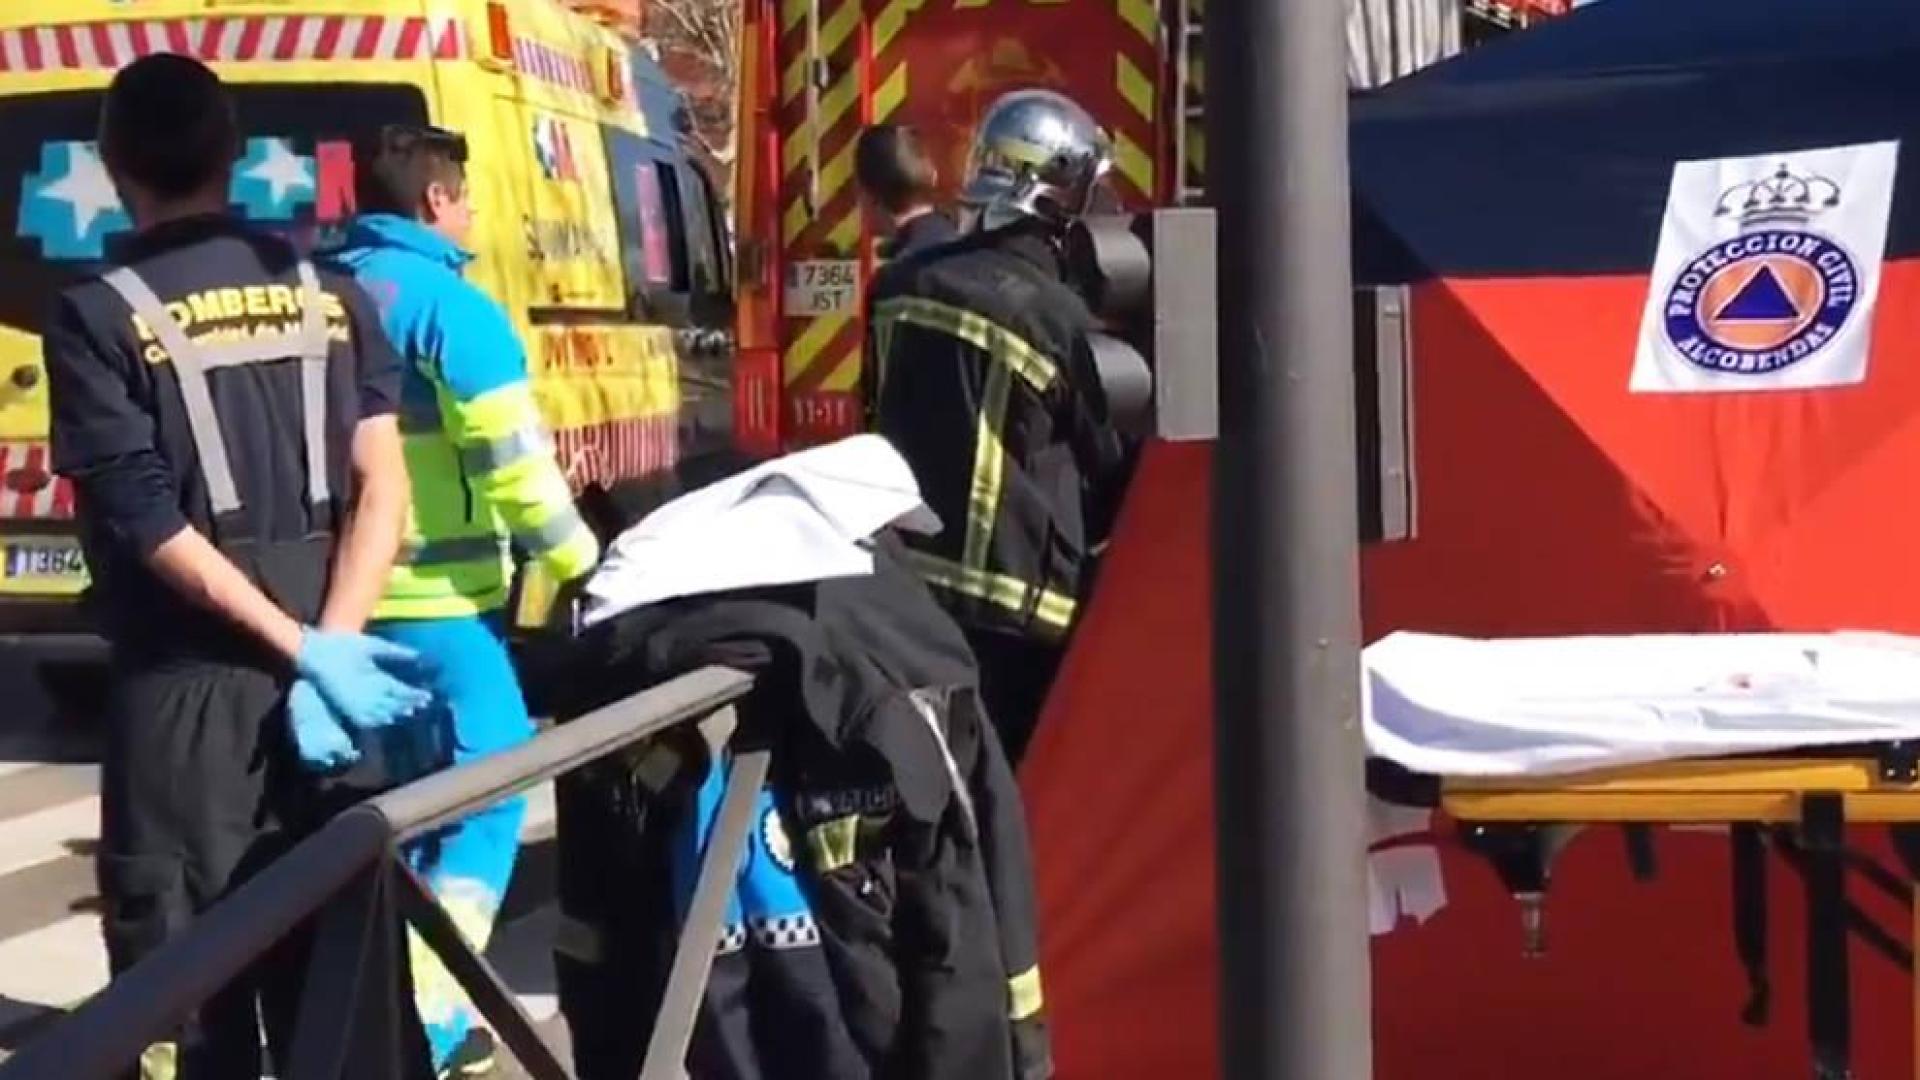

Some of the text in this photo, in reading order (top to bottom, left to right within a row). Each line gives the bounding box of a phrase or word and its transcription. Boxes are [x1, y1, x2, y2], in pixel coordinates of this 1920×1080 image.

[1669, 234, 1853, 315] PROTECCION CIVIL
[1678, 323, 1834, 371] ALCOBENDAS
